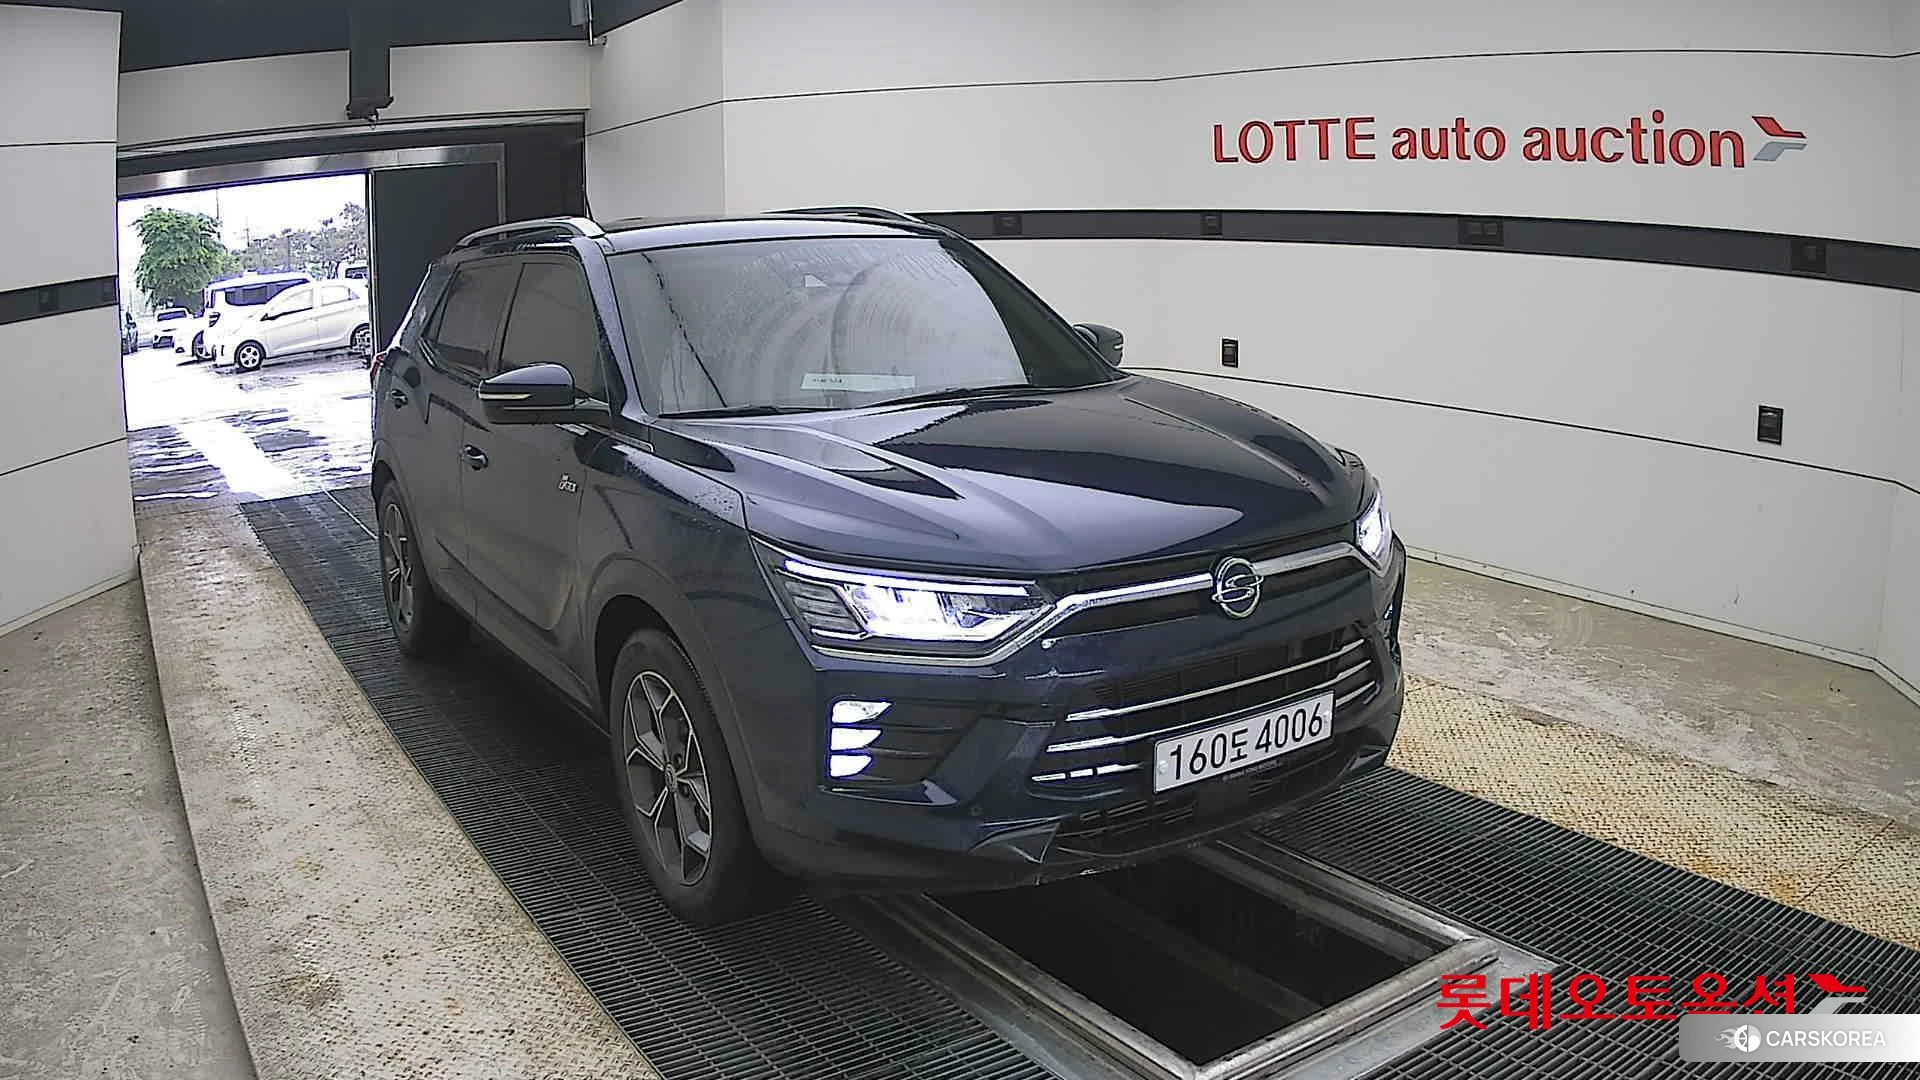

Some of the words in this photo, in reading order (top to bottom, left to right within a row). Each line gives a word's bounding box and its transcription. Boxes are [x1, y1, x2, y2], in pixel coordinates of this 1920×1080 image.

[1213, 117, 1376, 163] LOTTE
[1392, 117, 1507, 161] auto
[1522, 109, 1745, 168] auction
